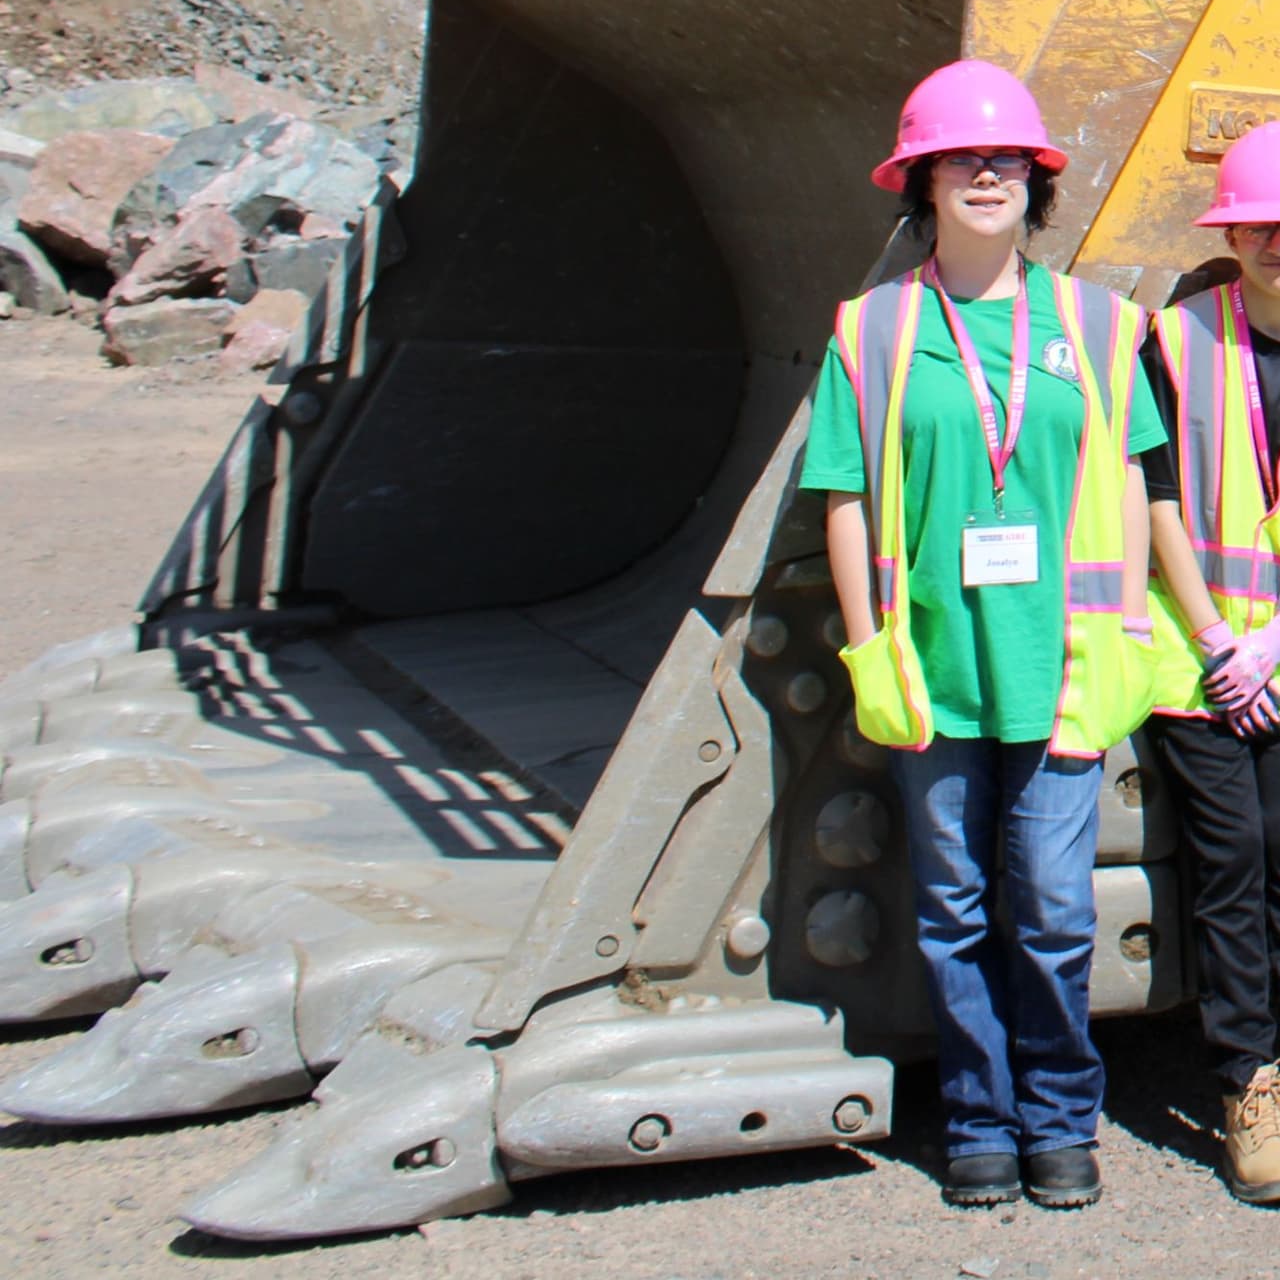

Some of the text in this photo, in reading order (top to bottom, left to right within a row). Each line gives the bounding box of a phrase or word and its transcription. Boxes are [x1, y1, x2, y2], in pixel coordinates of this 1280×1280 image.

[1012, 368, 1027, 404] GIRL
[1249, 384, 1261, 408] GIRL
[984, 412, 999, 447] GIRL
